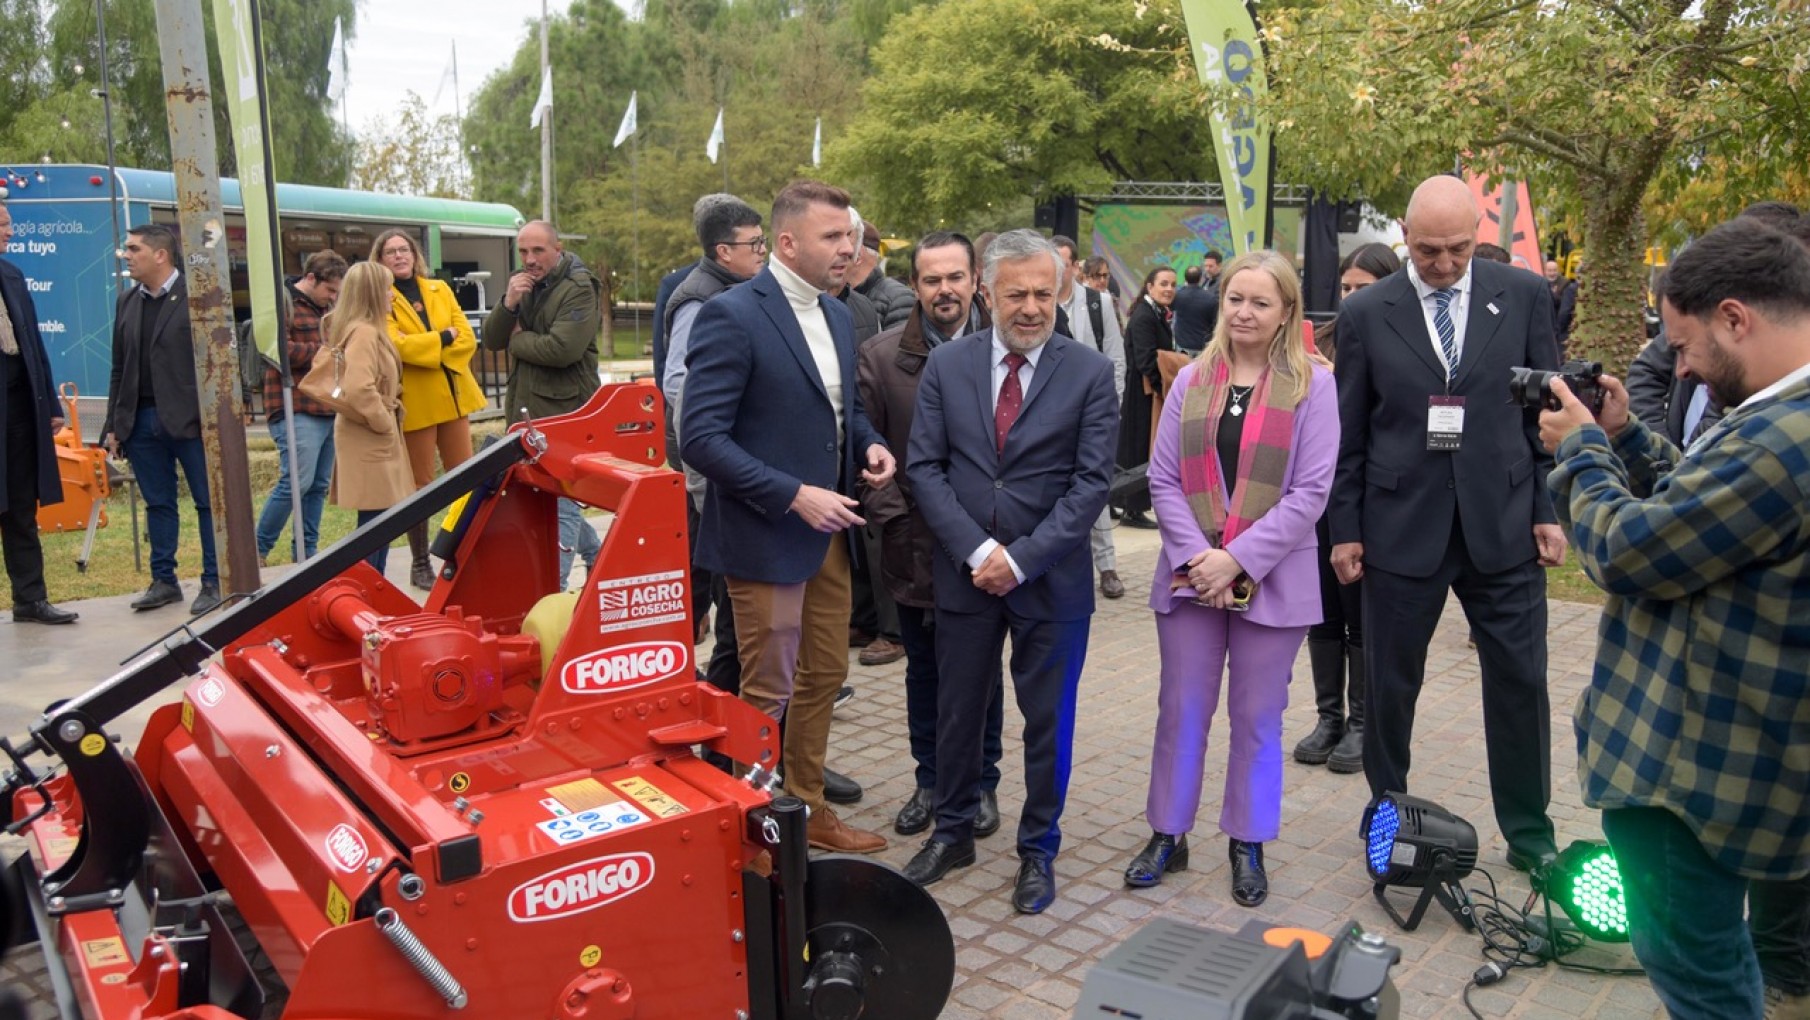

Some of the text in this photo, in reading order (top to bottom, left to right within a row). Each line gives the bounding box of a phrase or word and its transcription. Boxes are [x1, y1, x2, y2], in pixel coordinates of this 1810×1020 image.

[12, 220, 36, 237] ogía
[6, 240, 57, 256] rca tuyo
[24, 277, 53, 292] Tour
[630, 581, 685, 606] AGRO
[630, 599, 685, 618] COSECHA
[576, 647, 675, 690] FORIGO
[525, 859, 640, 917] FORIGO
